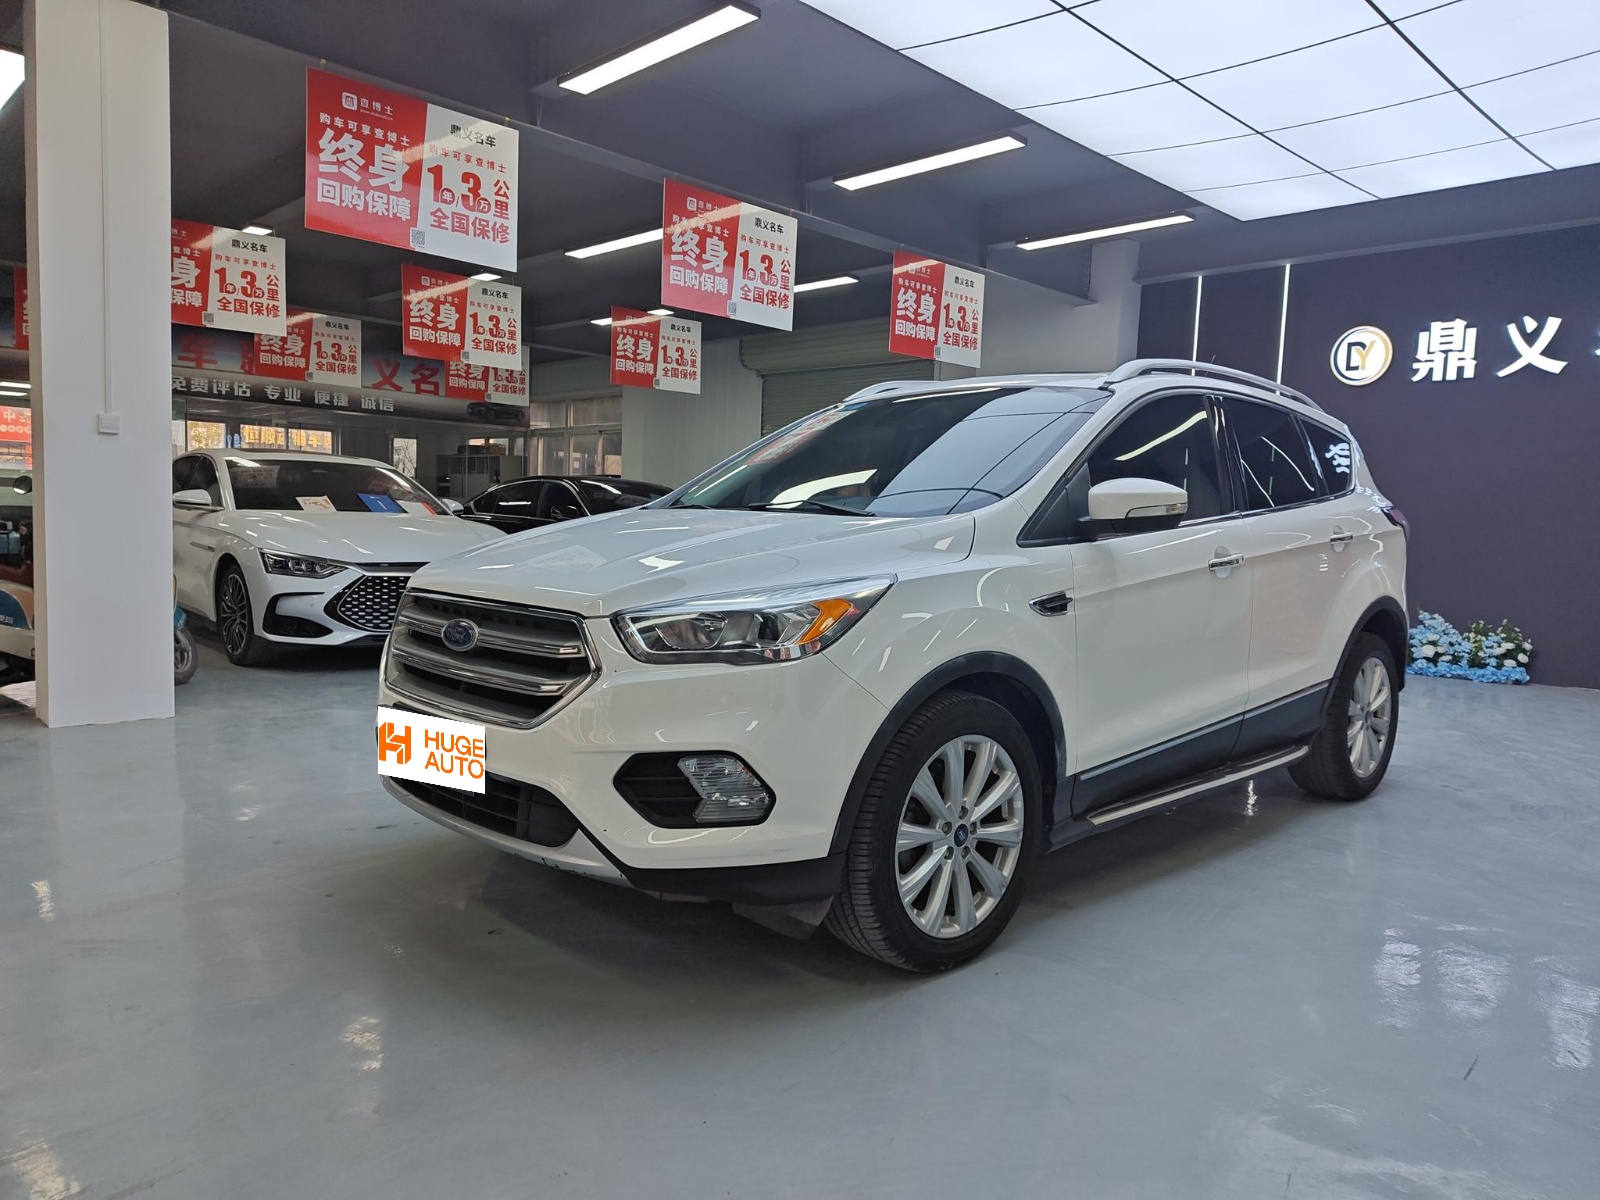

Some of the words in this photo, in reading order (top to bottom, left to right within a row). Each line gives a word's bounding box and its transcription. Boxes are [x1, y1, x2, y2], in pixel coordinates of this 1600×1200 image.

[319, 112, 410, 147] 购车可享查博士
[450, 124, 496, 148] 鼎义名车
[318, 128, 410, 192] 终身
[429, 144, 507, 174] 购车可享查博士
[317, 178, 411, 221] 回购保障
[429, 207, 510, 244] 全国保修
[754, 217, 784, 235] 鼎义名车
[231, 239, 268, 253] 鼎义名车
[670, 226, 728, 273] 终身
[669, 265, 728, 296] 回购保障
[954, 275, 975, 289] 鼎义名车
[481, 287, 509, 300] 鼎义名车
[740, 283, 790, 310] 全国保修
[217, 296, 280, 318] 全国保修
[409, 299, 459, 330] 终身
[896, 286, 937, 324] 终身
[325, 321, 350, 330] 鼎义名车
[409, 325, 461, 347] 回购保障
[670, 323, 692, 333] 鼎义名车
[895, 318, 935, 341] 回购保障
[260, 334, 305, 356] 终身
[472, 337, 517, 355] 全国保修
[616, 333, 654, 361] 终身
[943, 331, 978, 351] 全国保修
[1411, 315, 1600, 382] 鼎义
[260, 352, 306, 369] 回购保障
[315, 360, 358, 375] 全国保修
[449, 360, 485, 379] 终身
[615, 358, 655, 376] 回购保障
[449, 376, 486, 391] 回购保障
[661, 366, 698, 381] 全国保修
[172, 375, 250, 397] 免费评估
[264, 384, 302, 403] 专业
[314, 389, 350, 408] 便捷
[360, 394, 395, 412] 诚信
[493, 383, 526, 396] 全国保修
